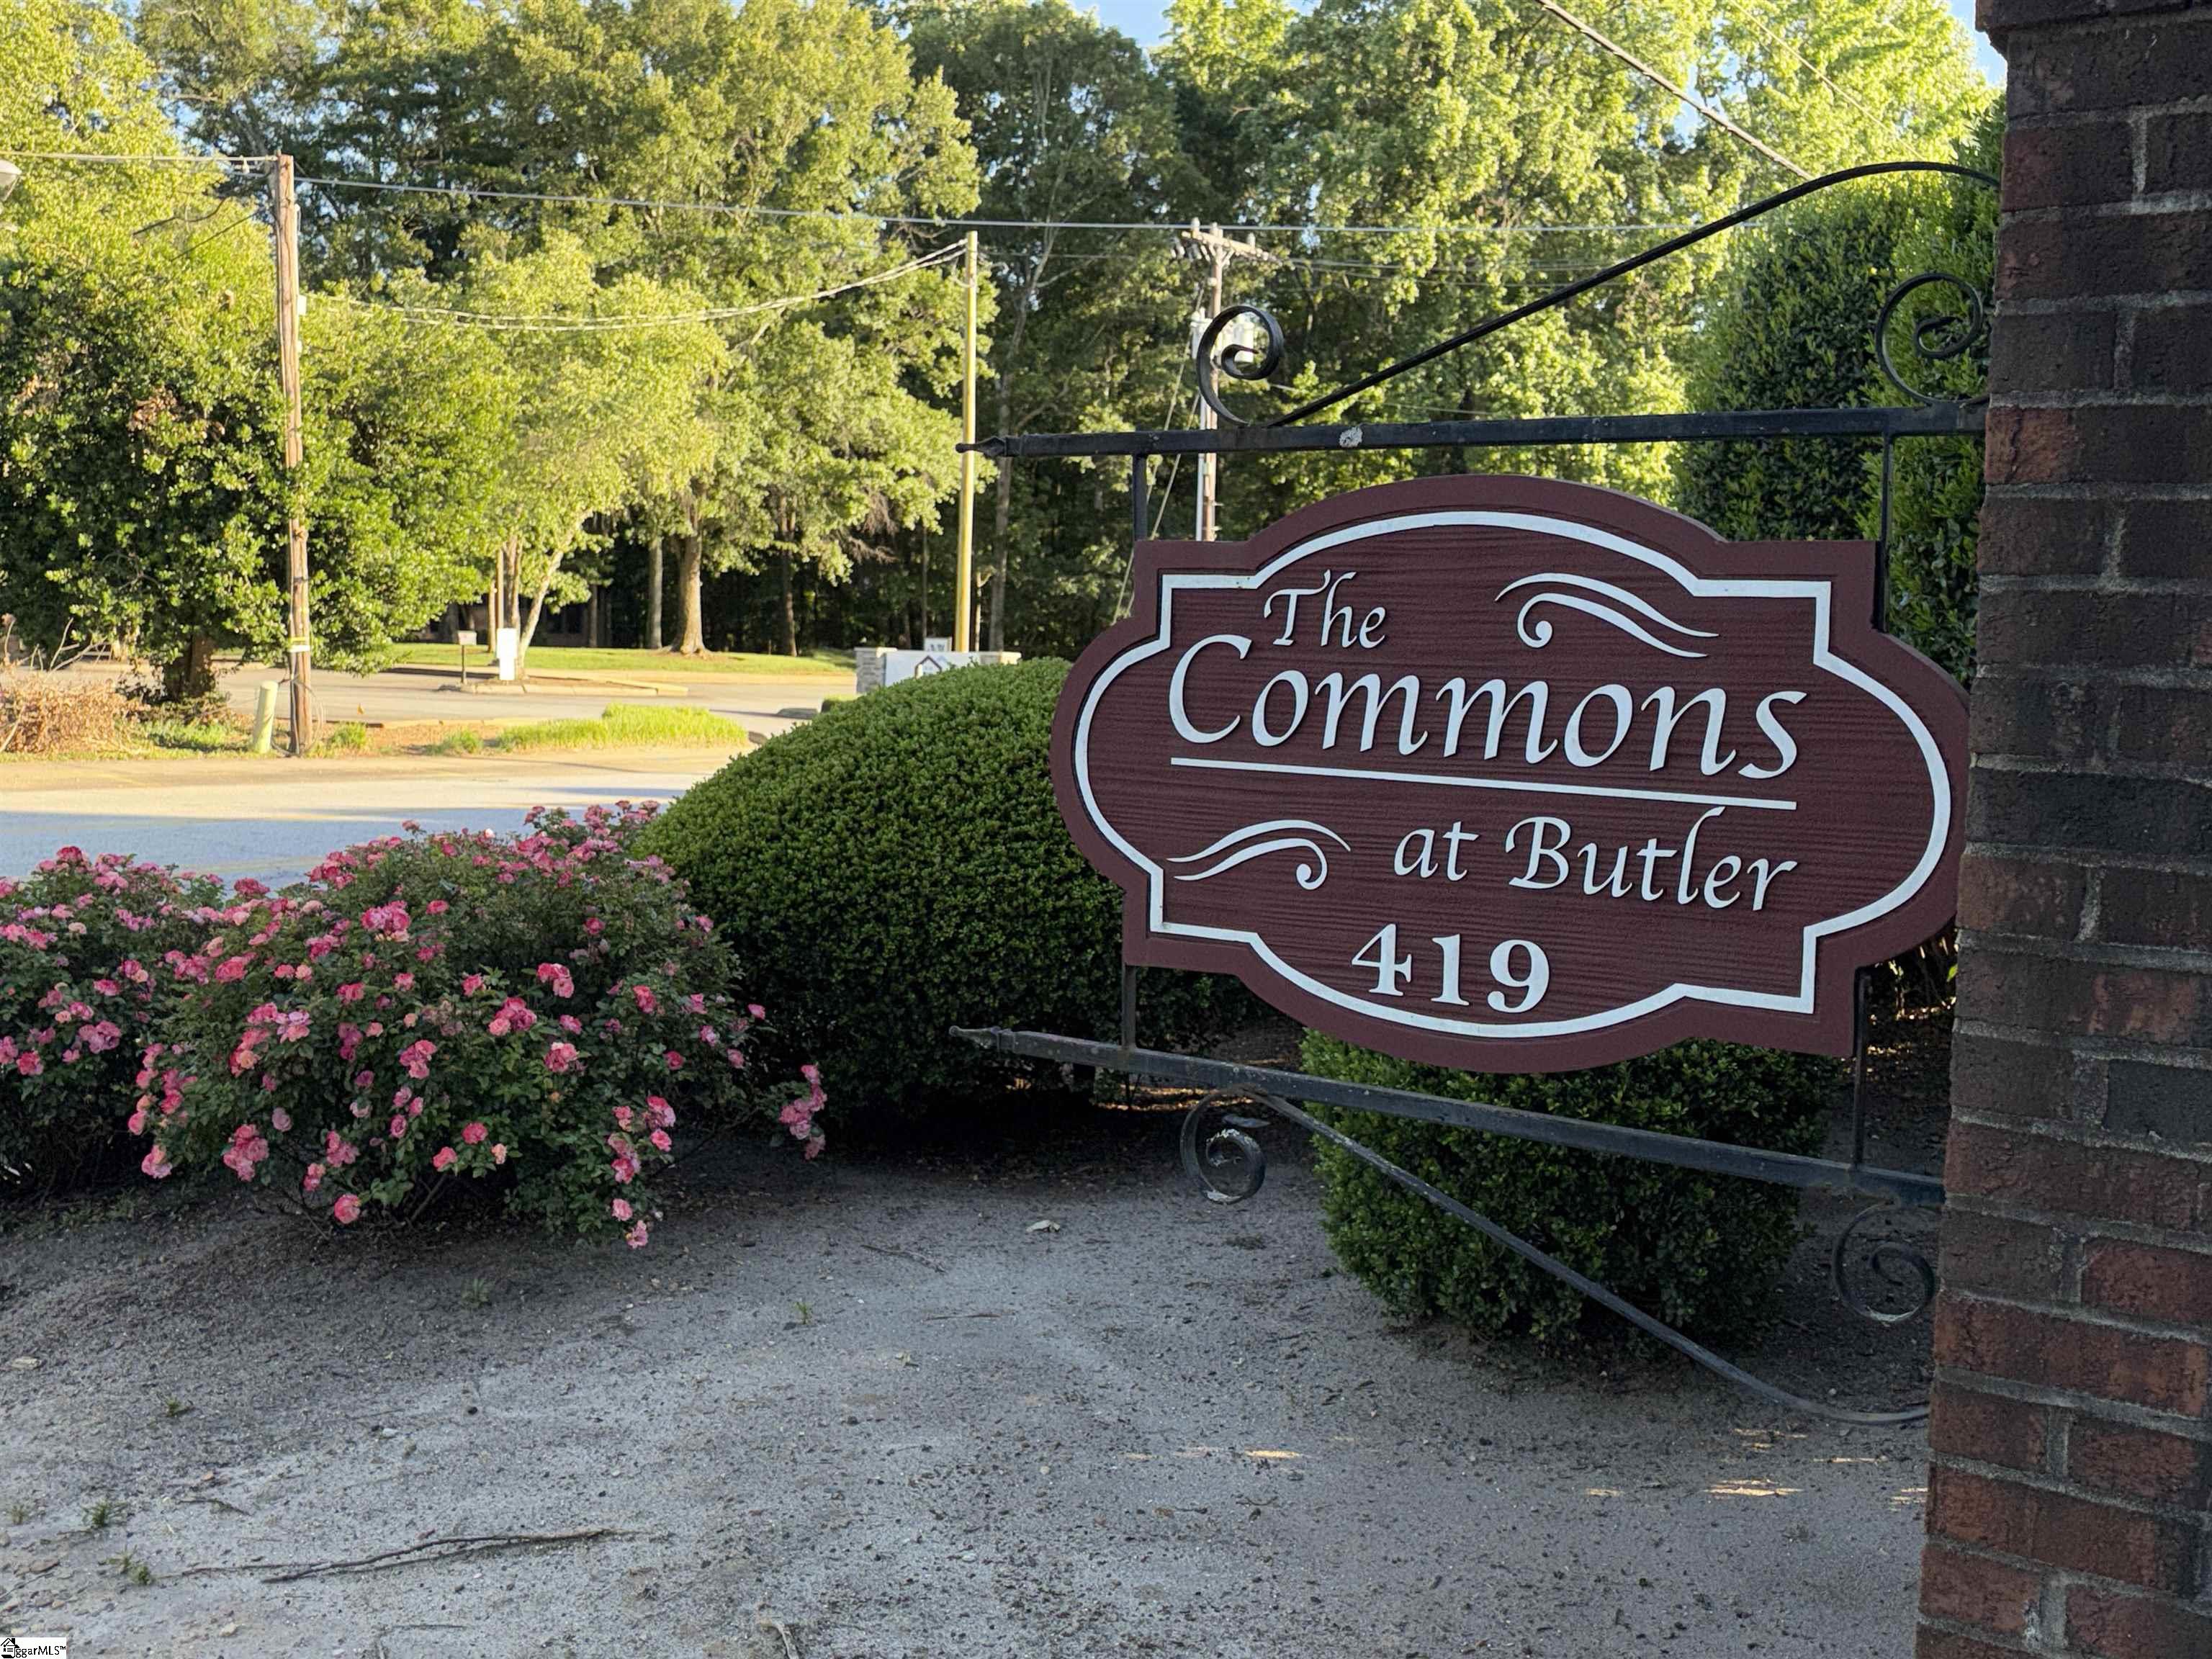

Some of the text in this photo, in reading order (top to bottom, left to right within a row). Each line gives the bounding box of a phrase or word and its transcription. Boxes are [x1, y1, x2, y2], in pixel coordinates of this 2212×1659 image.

[1262, 570, 1387, 649] The
[1168, 633, 1808, 780] Commons
[1393, 805, 1799, 912] at Butler
[1350, 922, 1550, 1014] 419
